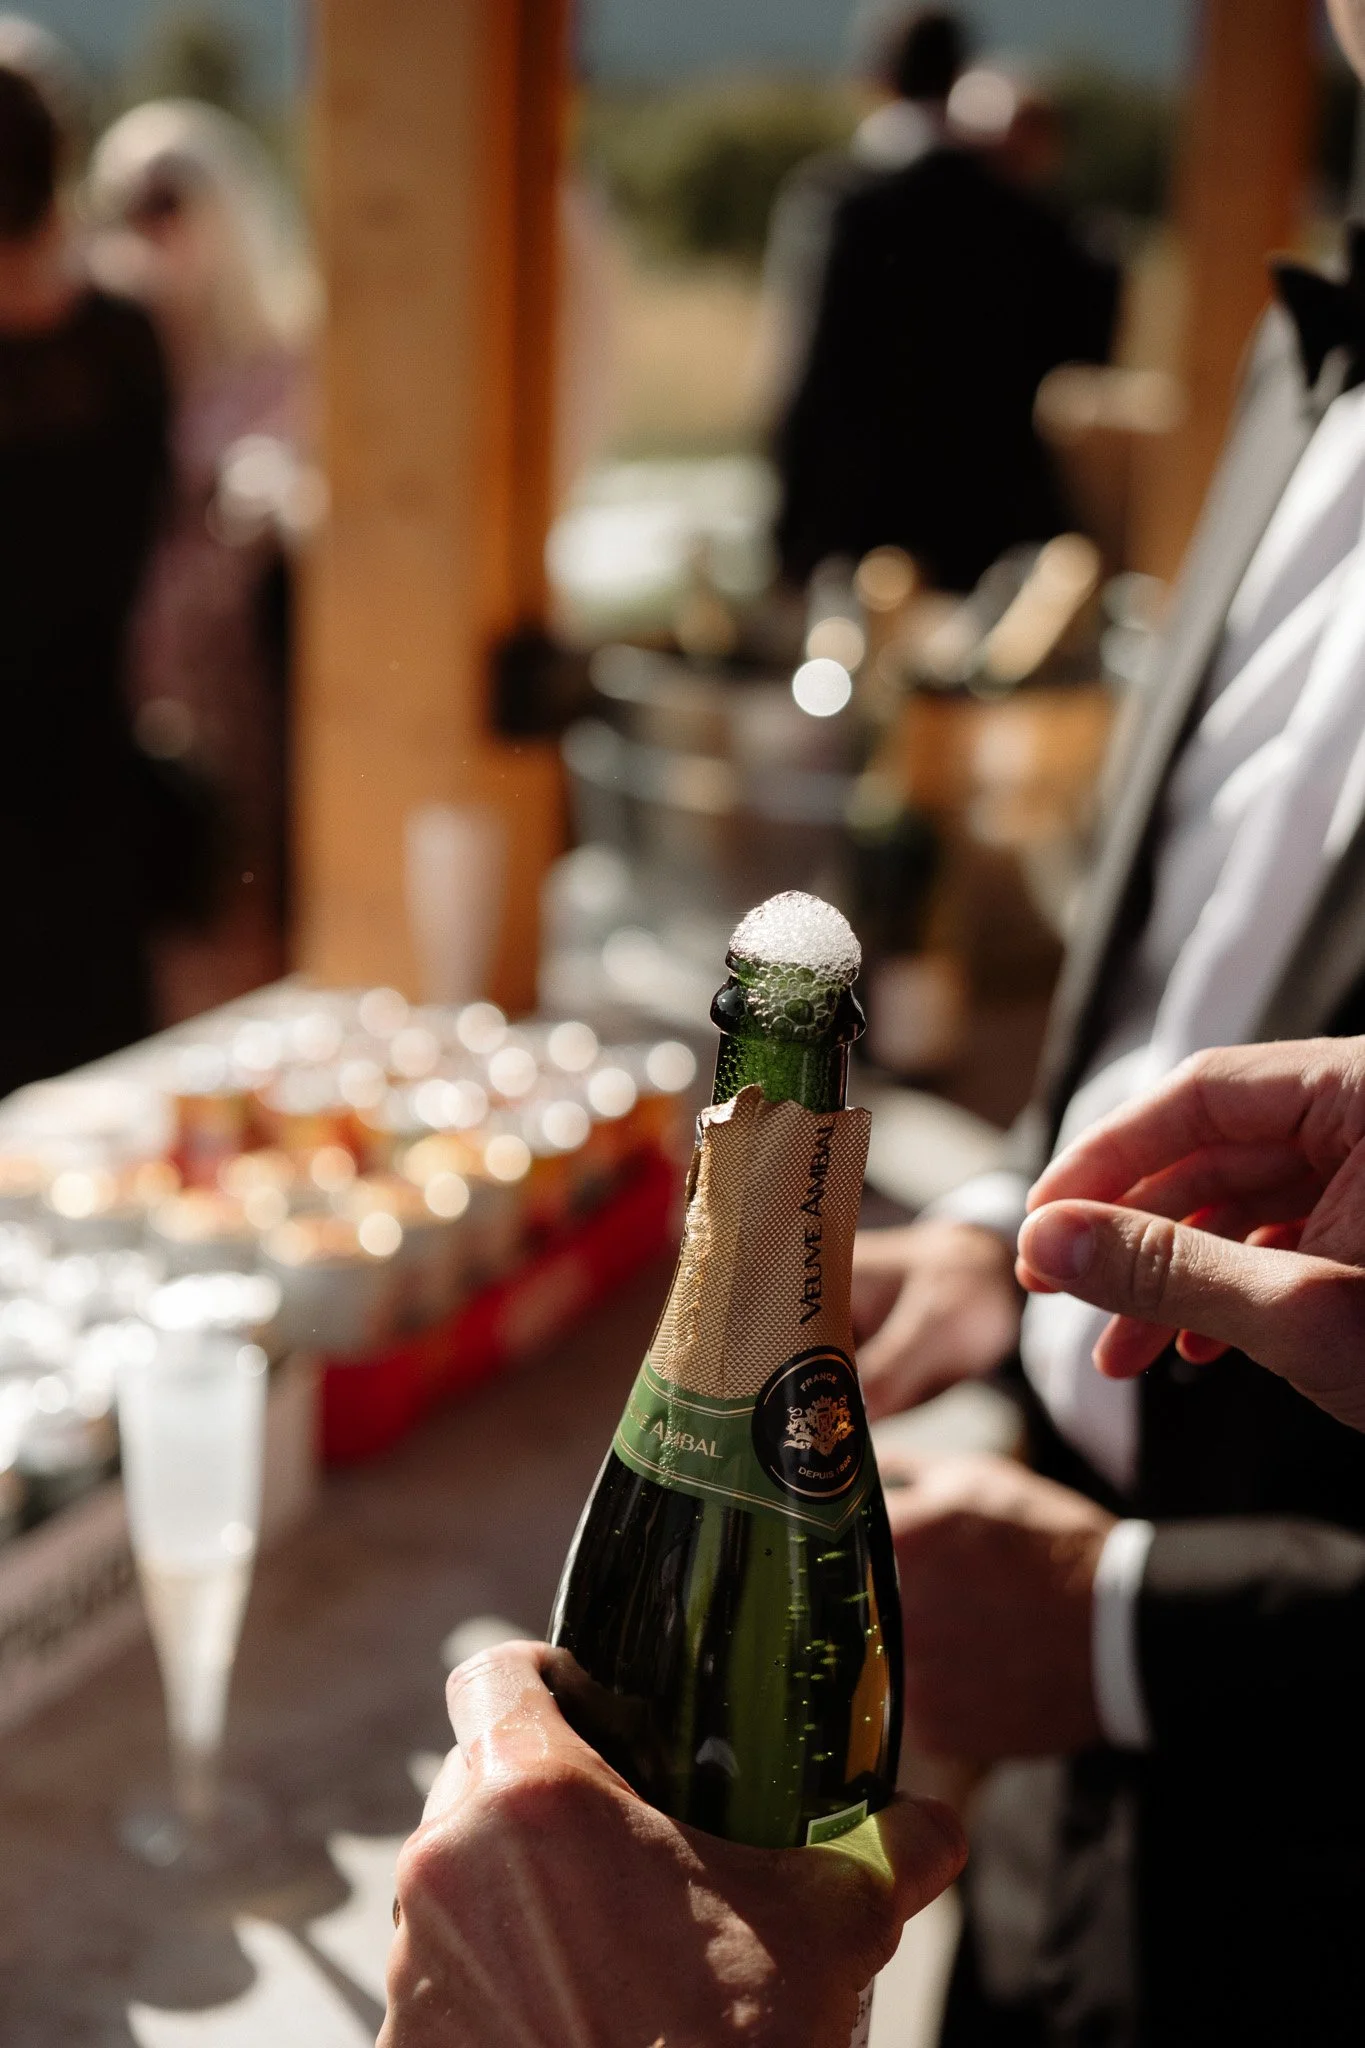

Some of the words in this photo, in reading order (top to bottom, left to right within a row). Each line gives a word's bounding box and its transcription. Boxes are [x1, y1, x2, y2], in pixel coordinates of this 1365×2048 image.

[800, 1116, 836, 1217] AMBAL
[800, 1223, 822, 1324] VEUVE
[800, 1372, 837, 1392] FRANCE
[649, 1419, 723, 1459] AMBAL
[798, 1466, 835, 1480] DEPUIS
